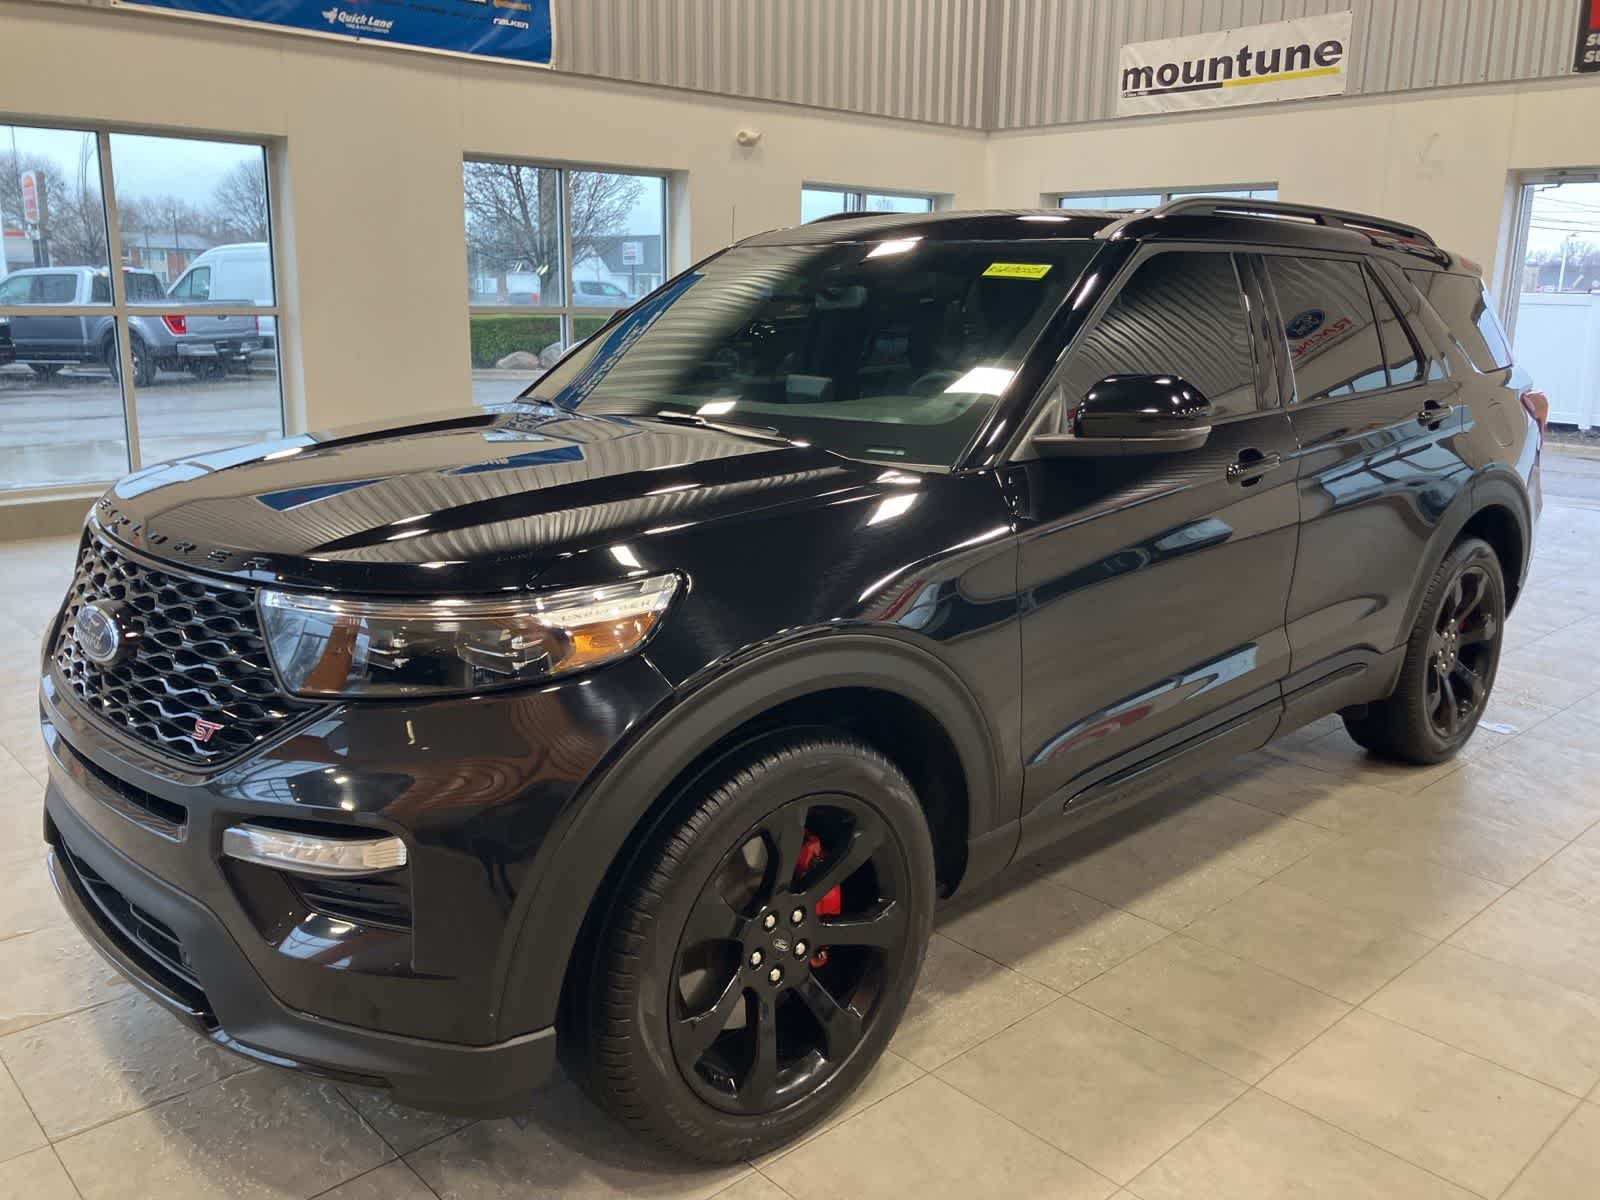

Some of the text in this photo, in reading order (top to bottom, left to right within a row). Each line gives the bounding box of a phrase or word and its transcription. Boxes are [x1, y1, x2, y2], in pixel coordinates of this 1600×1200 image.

[338, 11, 394, 29] Quick Lane
[1121, 38, 1344, 91] mountune
[191, 718, 225, 742] ST
